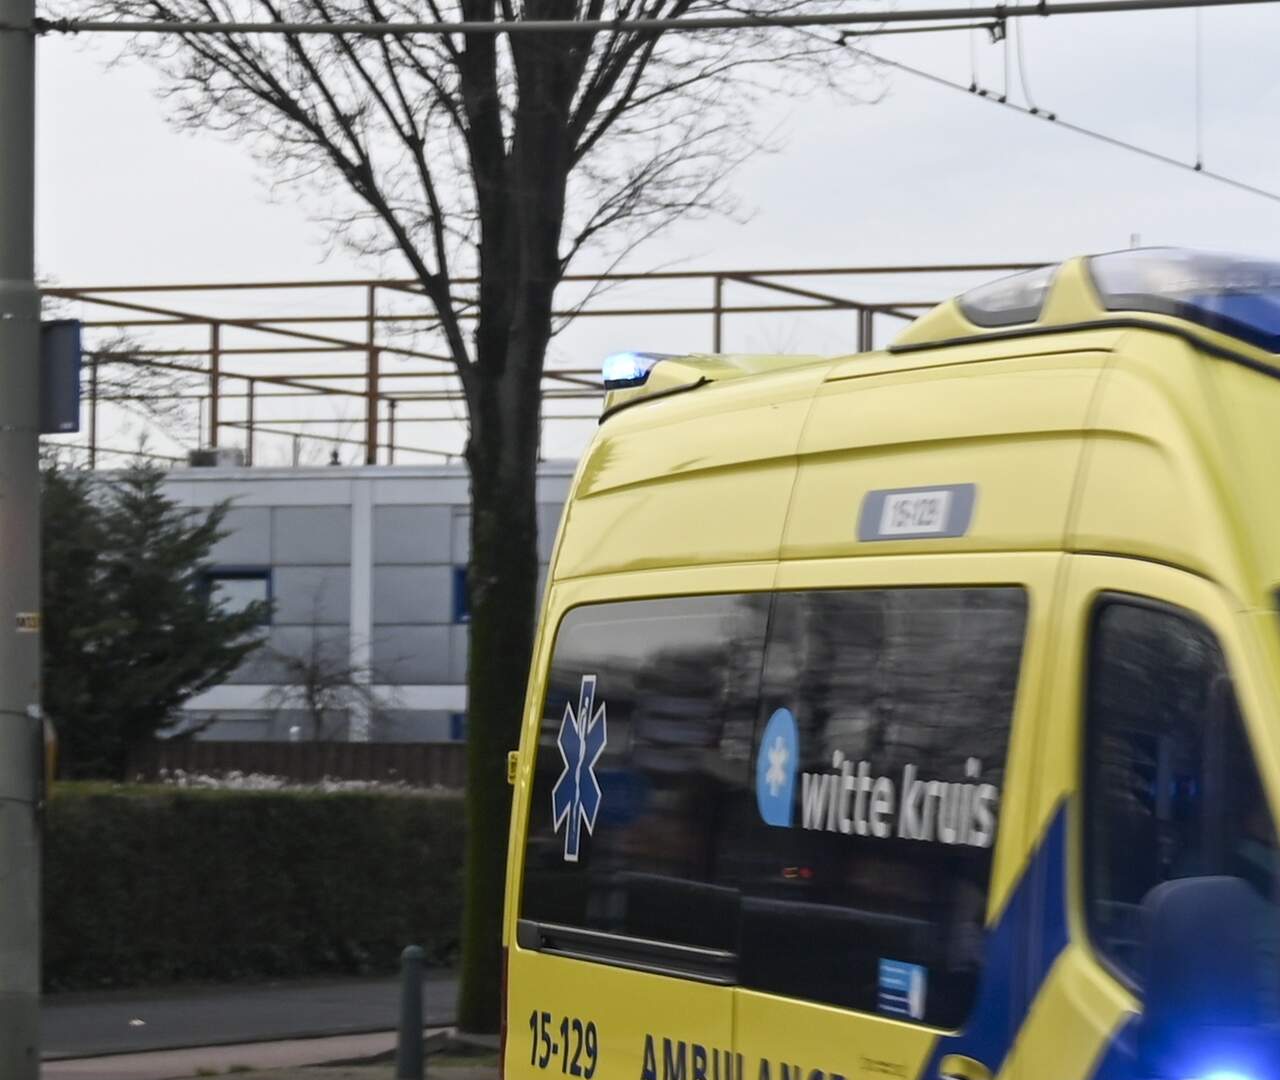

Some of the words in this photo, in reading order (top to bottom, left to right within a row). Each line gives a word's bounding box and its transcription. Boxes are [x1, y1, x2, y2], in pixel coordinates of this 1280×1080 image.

[802, 749, 895, 838] witte
[898, 757, 998, 848] kruis
[529, 1010, 598, 1080] 15-129
